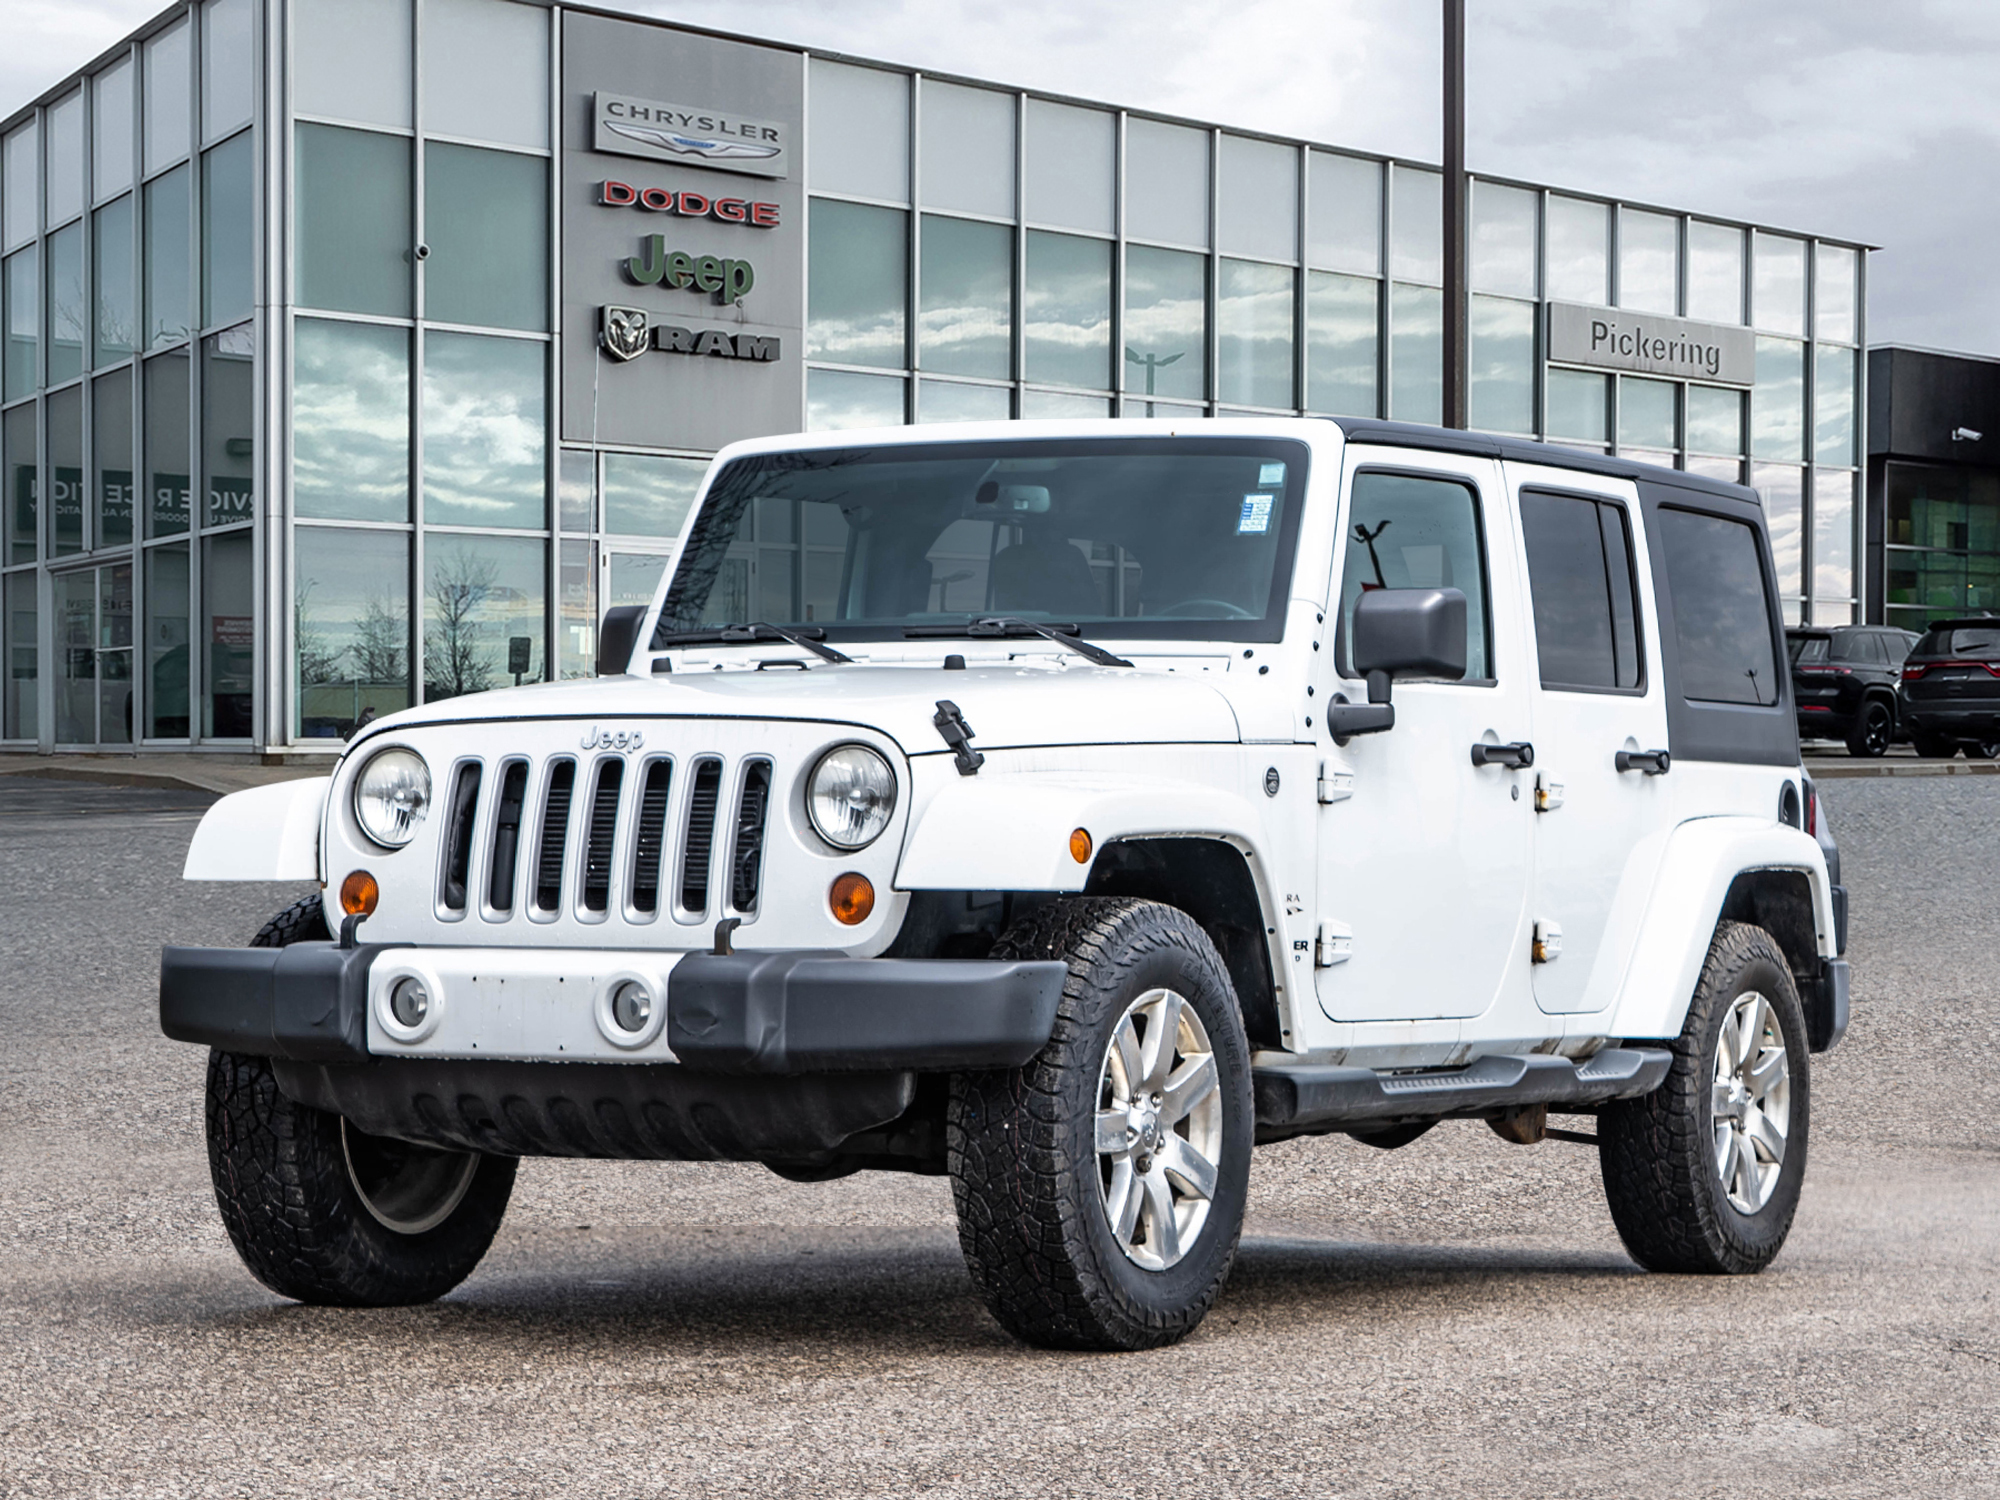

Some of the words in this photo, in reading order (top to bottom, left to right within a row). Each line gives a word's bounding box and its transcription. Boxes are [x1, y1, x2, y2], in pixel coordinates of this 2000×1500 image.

[606, 101, 780, 143] CHRYSLER
[603, 180, 781, 227] DODGE
[626, 233, 755, 305] Jeep
[655, 324, 781, 361] RAM
[1591, 321, 1721, 376] Pickering
[580, 725, 645, 754] Jeep
